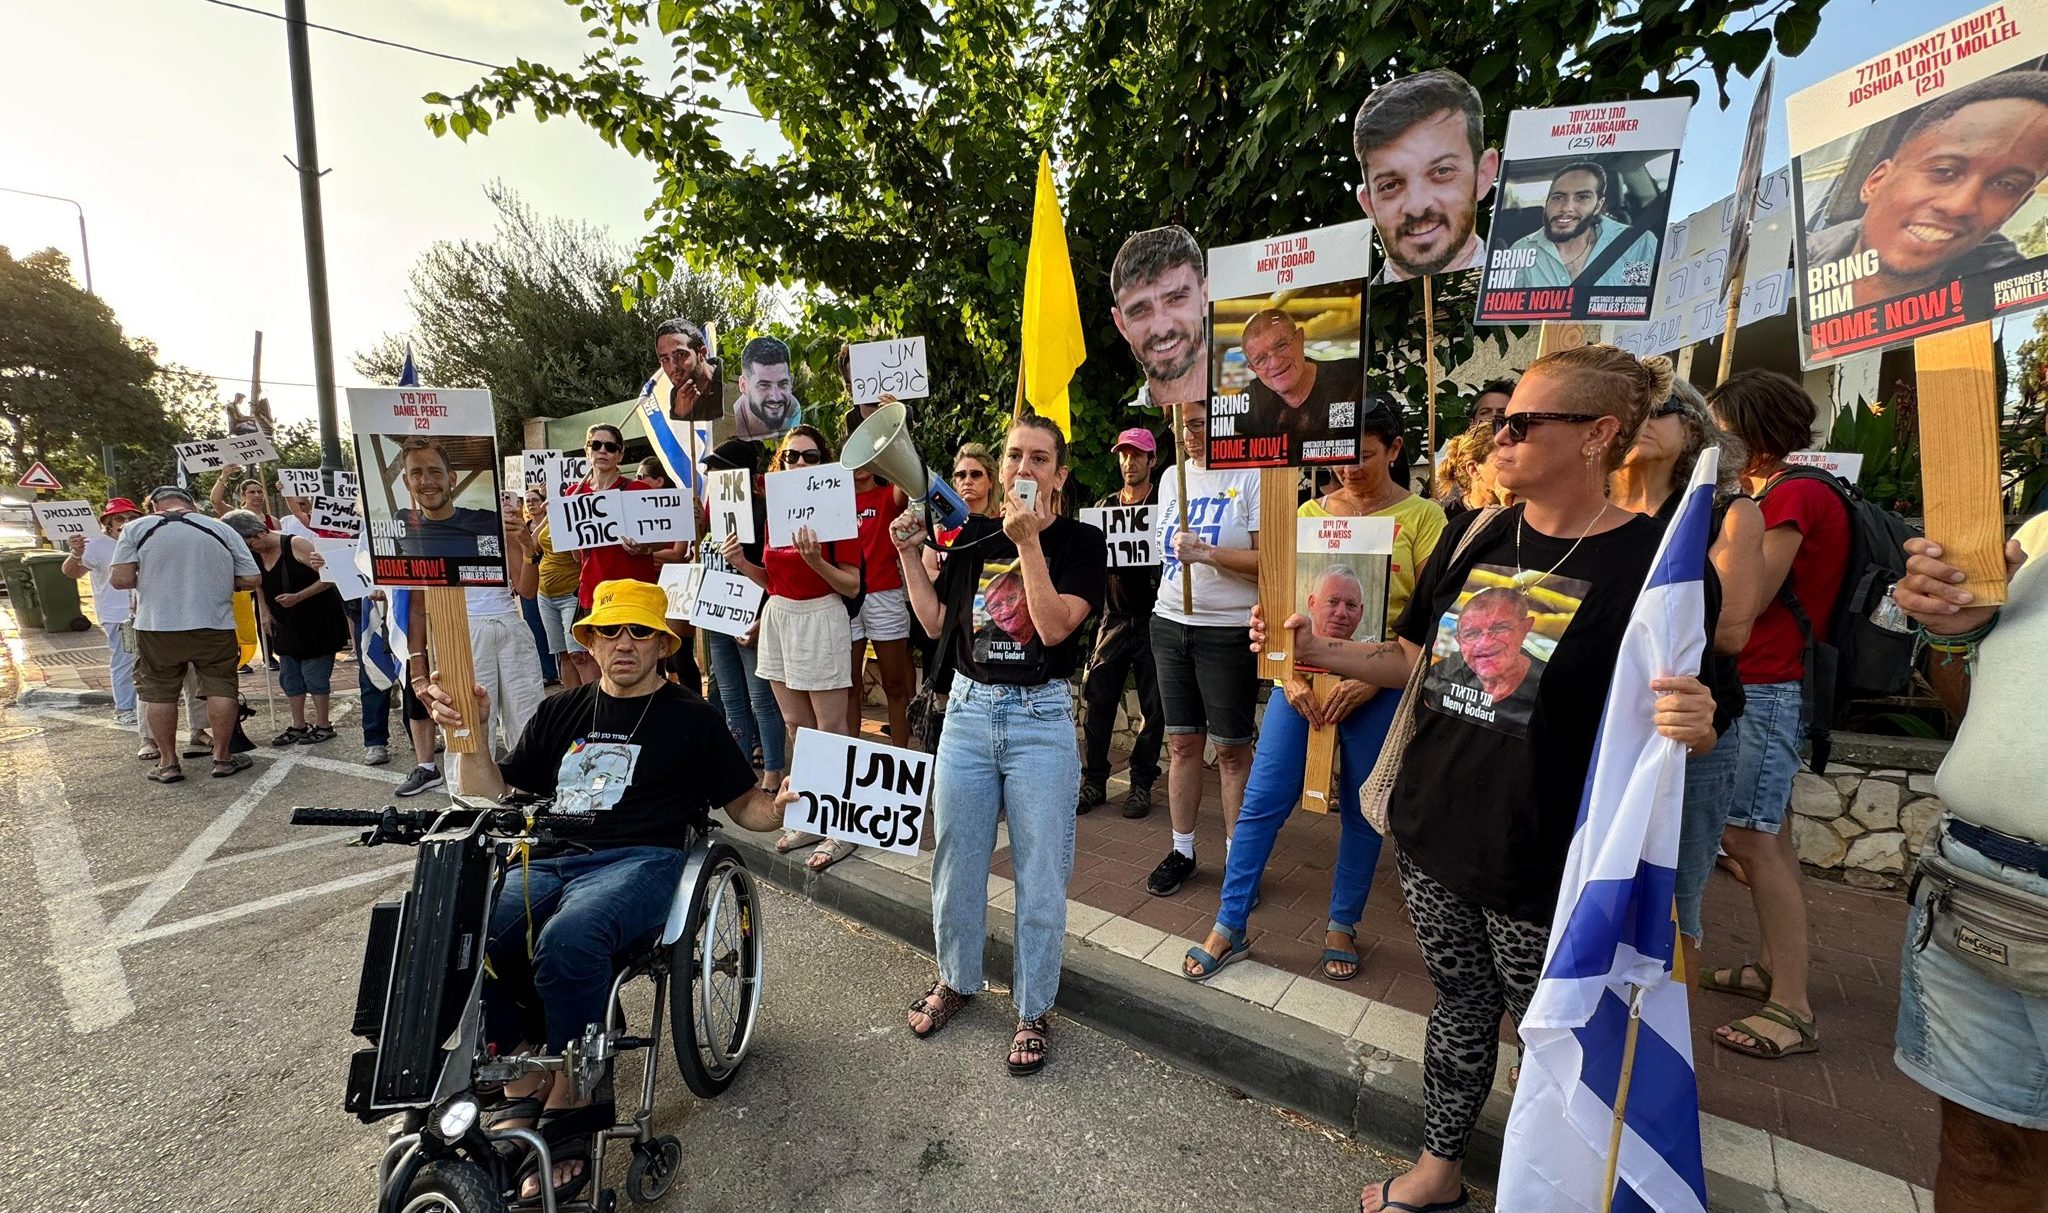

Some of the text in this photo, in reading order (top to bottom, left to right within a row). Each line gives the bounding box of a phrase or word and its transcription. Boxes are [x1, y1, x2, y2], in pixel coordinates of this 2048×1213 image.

[1895, 32, 1946, 67] לואיטו
[1848, 21, 2021, 107] JOSHUA LOITU MOLLEL
[1856, 58, 1891, 85] מולל
[1916, 69, 1945, 96] (21)
[1569, 107, 1626, 123] מתן צנגאוקר
[1551, 119, 1638, 137] MATAN ZANGAUKER
[1568, 136, 1595, 150] (25)
[1264, 237, 1308, 257] מני גודארד
[1257, 251, 1315, 273] MENY GODARD
[1491, 248, 1537, 269] BRING
[1277, 268, 1294, 285] (73)
[1487, 269, 1517, 289] HIM
[1807, 249, 1879, 294] BRING
[1994, 272, 2042, 292] HOSTAGES
[1484, 287, 1574, 311] HOME NOW!
[1587, 302, 1646, 313] FAMILIES FORUM
[1809, 287, 1854, 321] HIM
[1810, 280, 1963, 350] HOME NOW!
[881, 341, 916, 369] מני
[400, 392, 437, 404] דניאל פרץ
[1211, 393, 1250, 416] BRING
[394, 404, 448, 417] DANIEL PERETZ
[414, 418, 430, 430] (22)
[1211, 416, 1235, 437] HIM
[229, 438, 258, 450] ענבר
[1210, 436, 1288, 460] HOME NOW!
[1303, 446, 1355, 458] FAMILIES FORUM
[201, 456, 224, 468] אור
[239, 448, 265, 461] הימן
[294, 482, 321, 496] כהן
[806, 476, 841, 492] אריאל
[641, 495, 680, 508] עמרי
[42, 507, 92, 520] פונגסאק
[563, 493, 608, 532] אלון
[788, 506, 815, 520] קוניו
[320, 515, 361, 532] David
[370, 520, 406, 538] BRING
[637, 518, 672, 536] מירן
[1102, 507, 1149, 540] איתן
[1322, 520, 1348, 530] אילן וייס
[1318, 530, 1352, 539] ILAN WEISS
[373, 538, 396, 556] HIM
[1107, 540, 1150, 568] הורן
[1328, 540, 1340, 550] (56)
[376, 558, 446, 578] HOME NOW!
[459, 572, 504, 581] FAMILIES FORUM
[726, 582, 744, 598] בר
[696, 600, 755, 626] קופרשטיין
[988, 650, 1025, 660] Meny Godard
[1450, 682, 1494, 708] מני גודארד
[1442, 694, 1496, 723] Meny Godard
[842, 745, 926, 800] מתן
